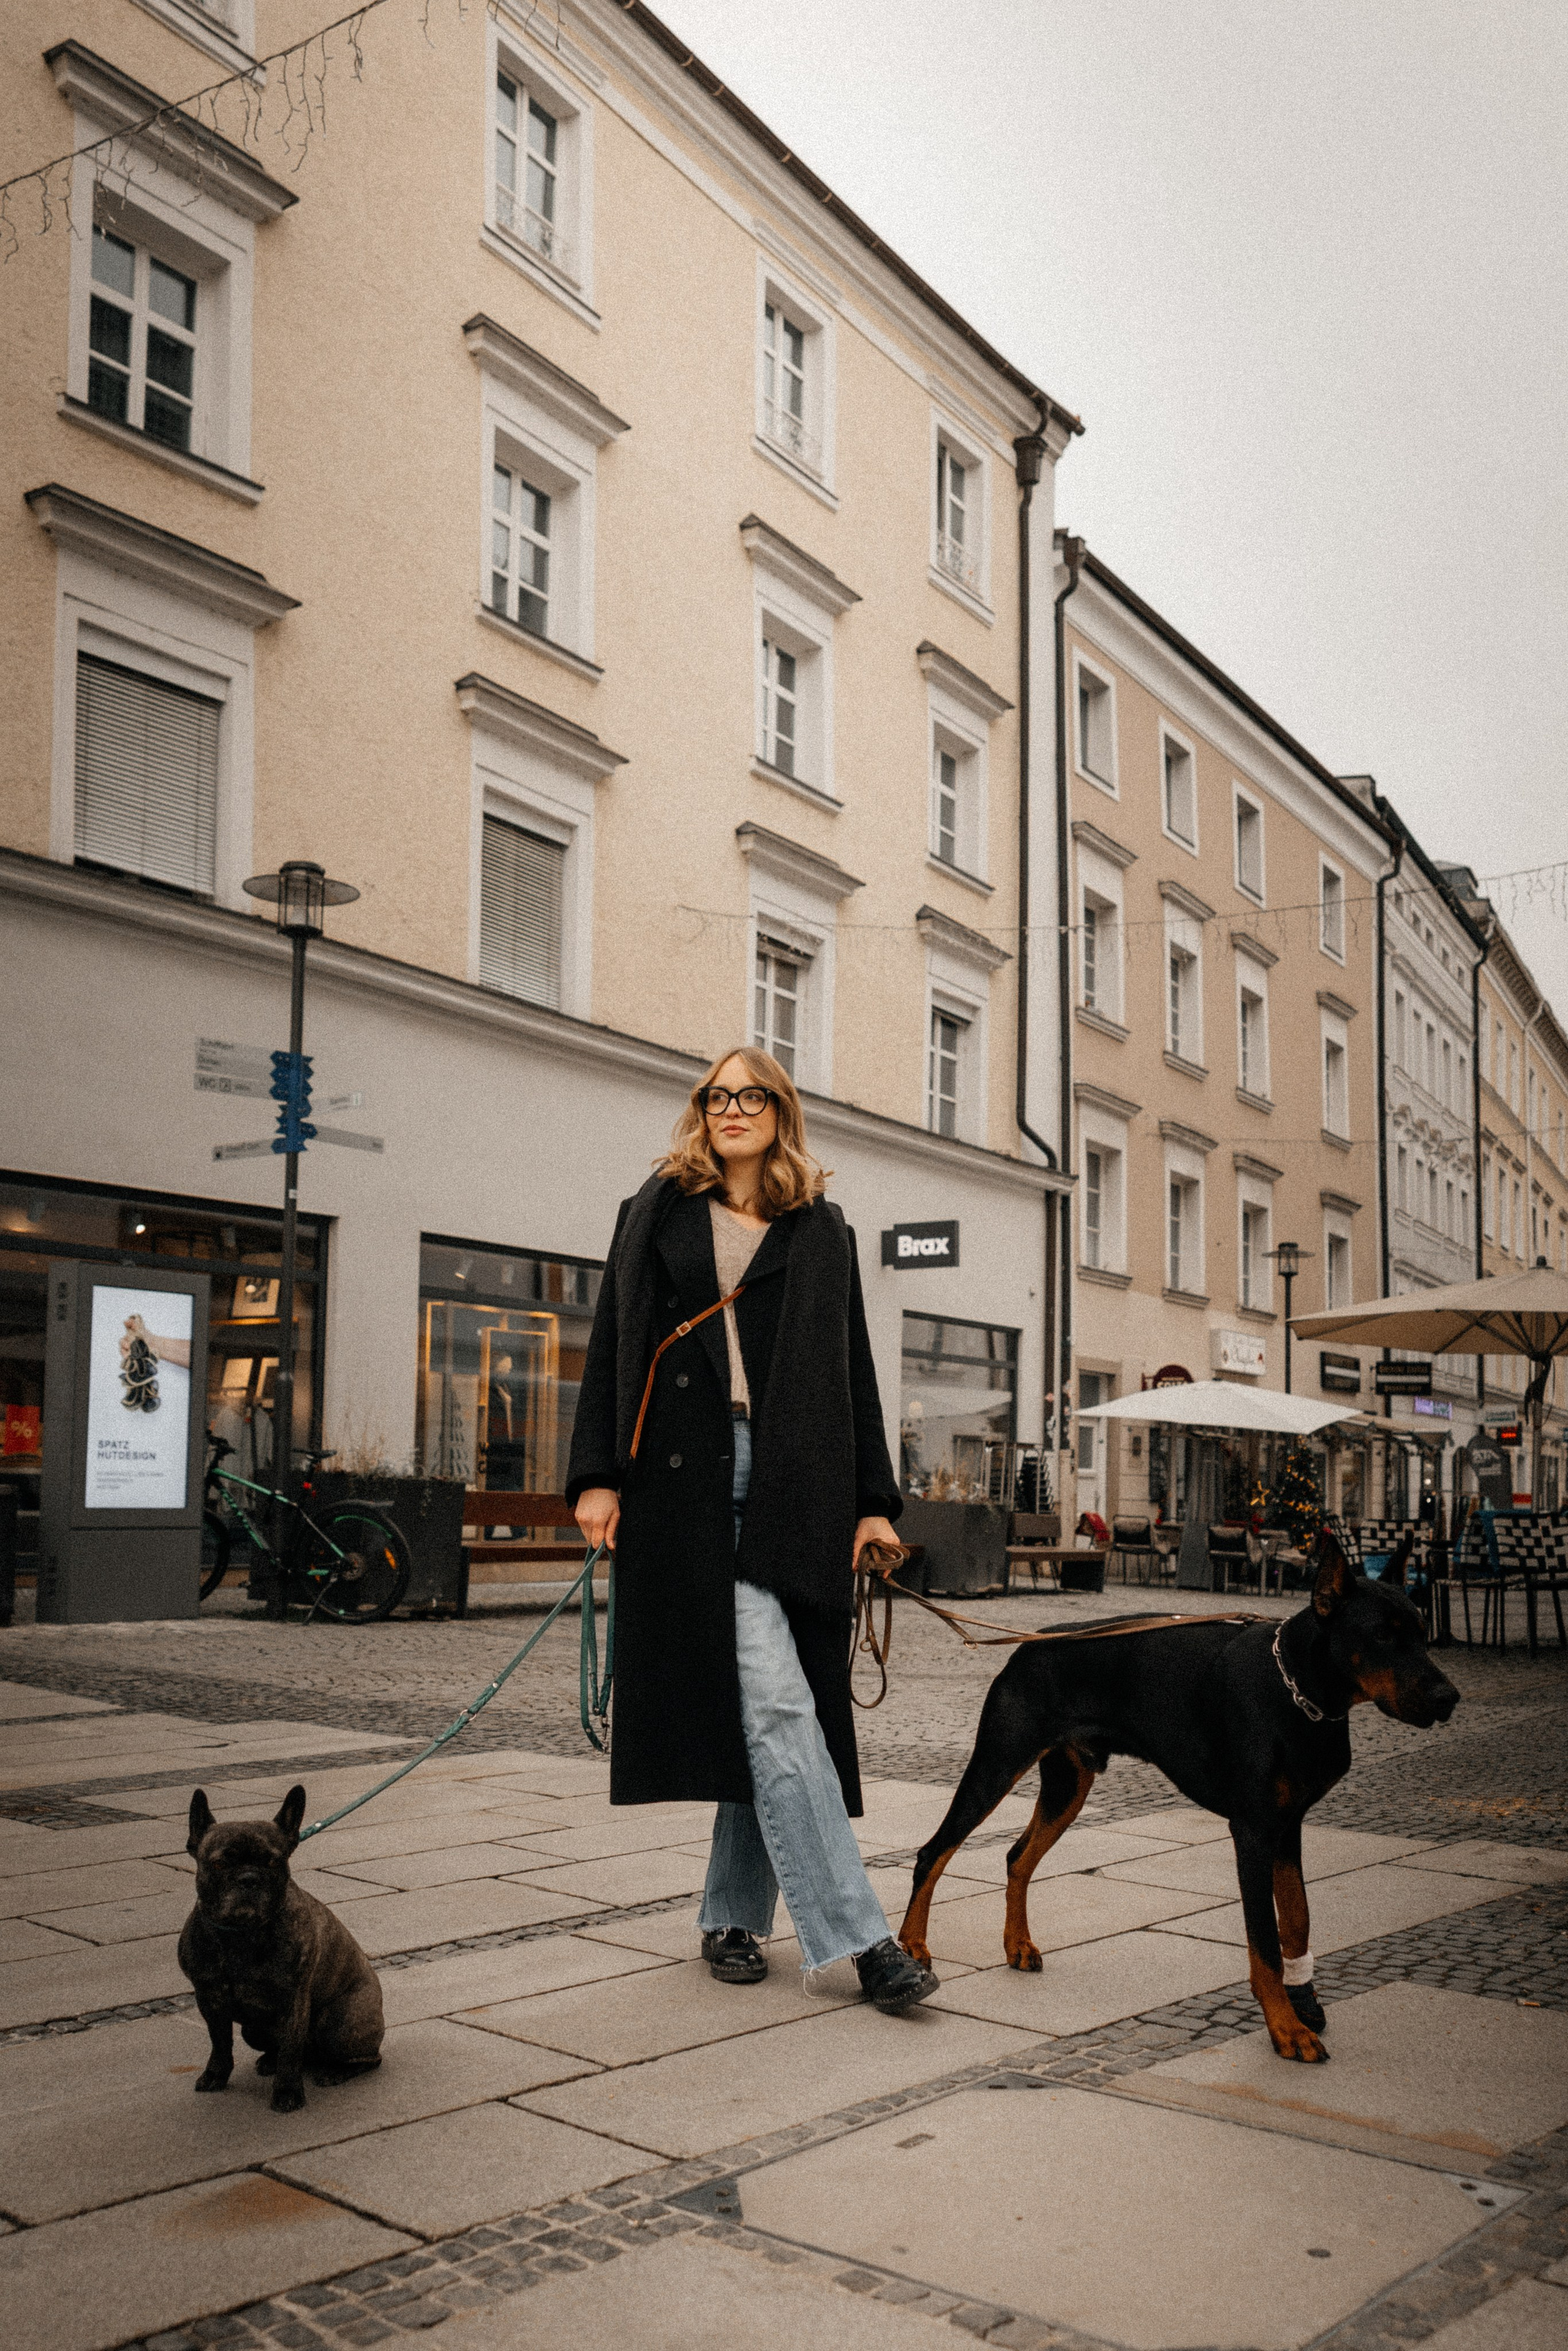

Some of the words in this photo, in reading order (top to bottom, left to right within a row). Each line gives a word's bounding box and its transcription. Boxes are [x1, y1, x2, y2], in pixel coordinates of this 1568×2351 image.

[897, 1235, 950, 1257] Brax
[11, 1421, 32, 1439] %
[99, 1440, 129, 1449] SPATZ
[97, 1451, 156, 1460] HUTDESIGN
